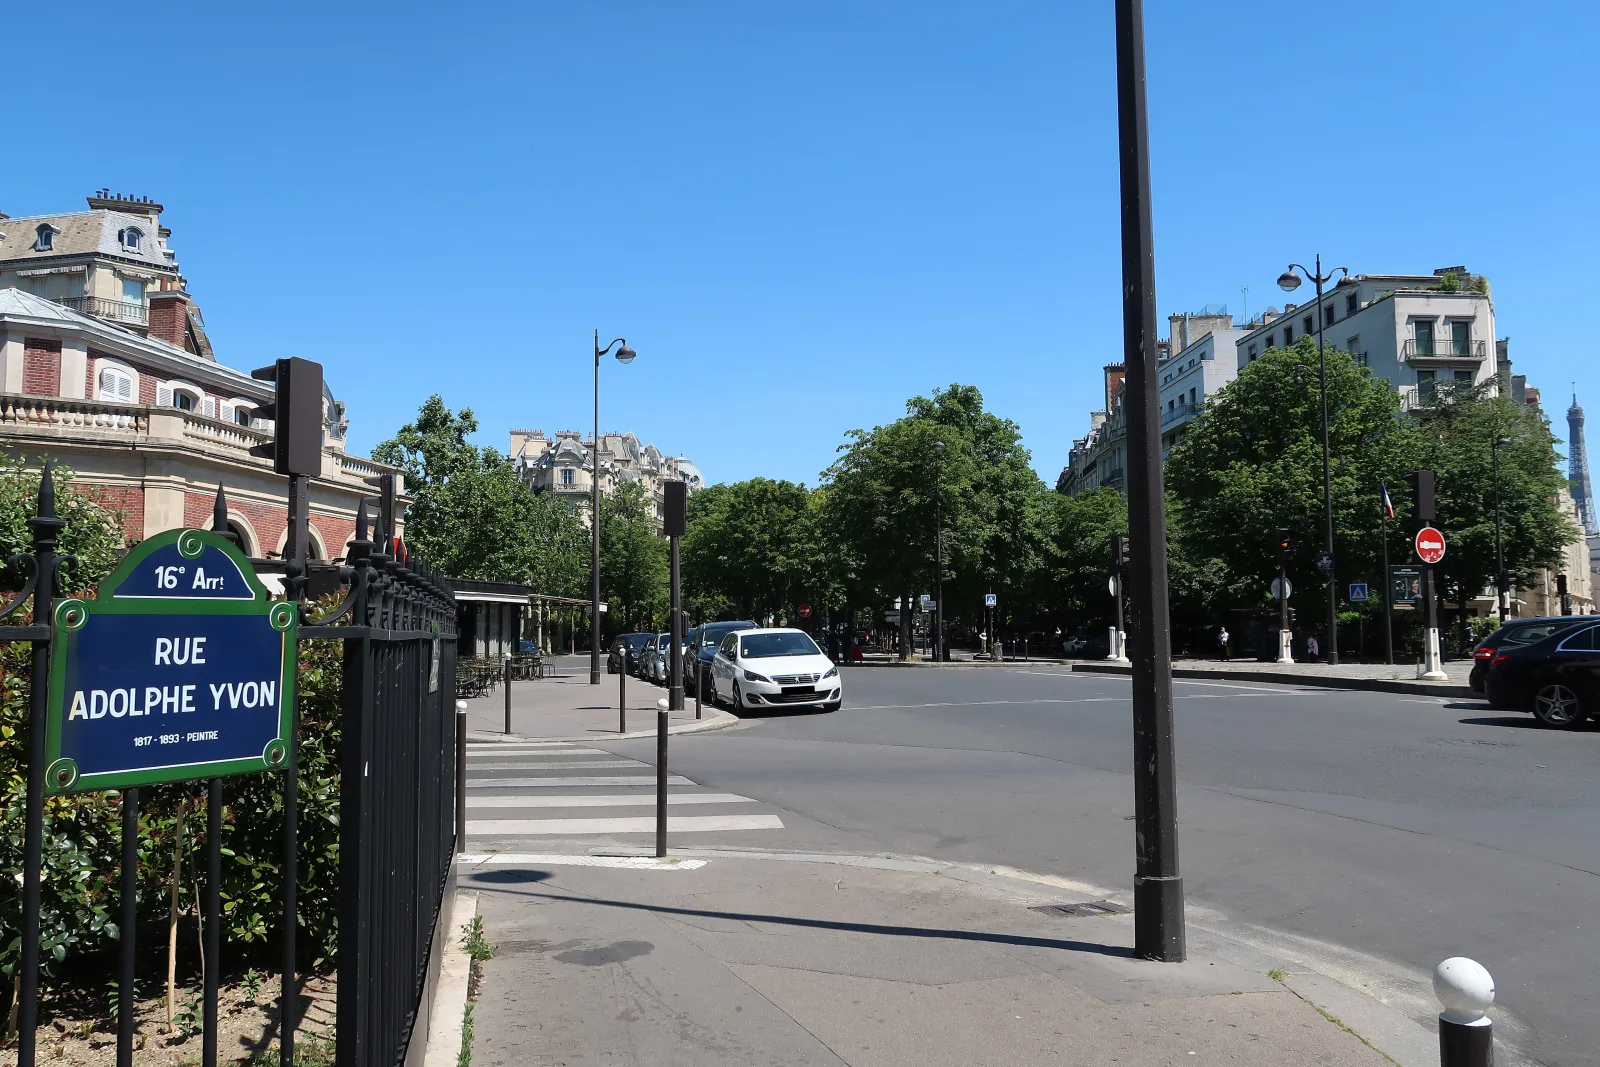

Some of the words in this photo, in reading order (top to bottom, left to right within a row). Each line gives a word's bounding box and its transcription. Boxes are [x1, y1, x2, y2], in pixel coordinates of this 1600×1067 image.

[154, 637, 207, 665] RUE
[68, 684, 196, 720] ADOLPHE
[209, 680, 276, 710] YVON
[133, 735, 153, 747] 1817
[159, 733, 180, 745] 1893
[186, 730, 219, 742] PEINTRE
